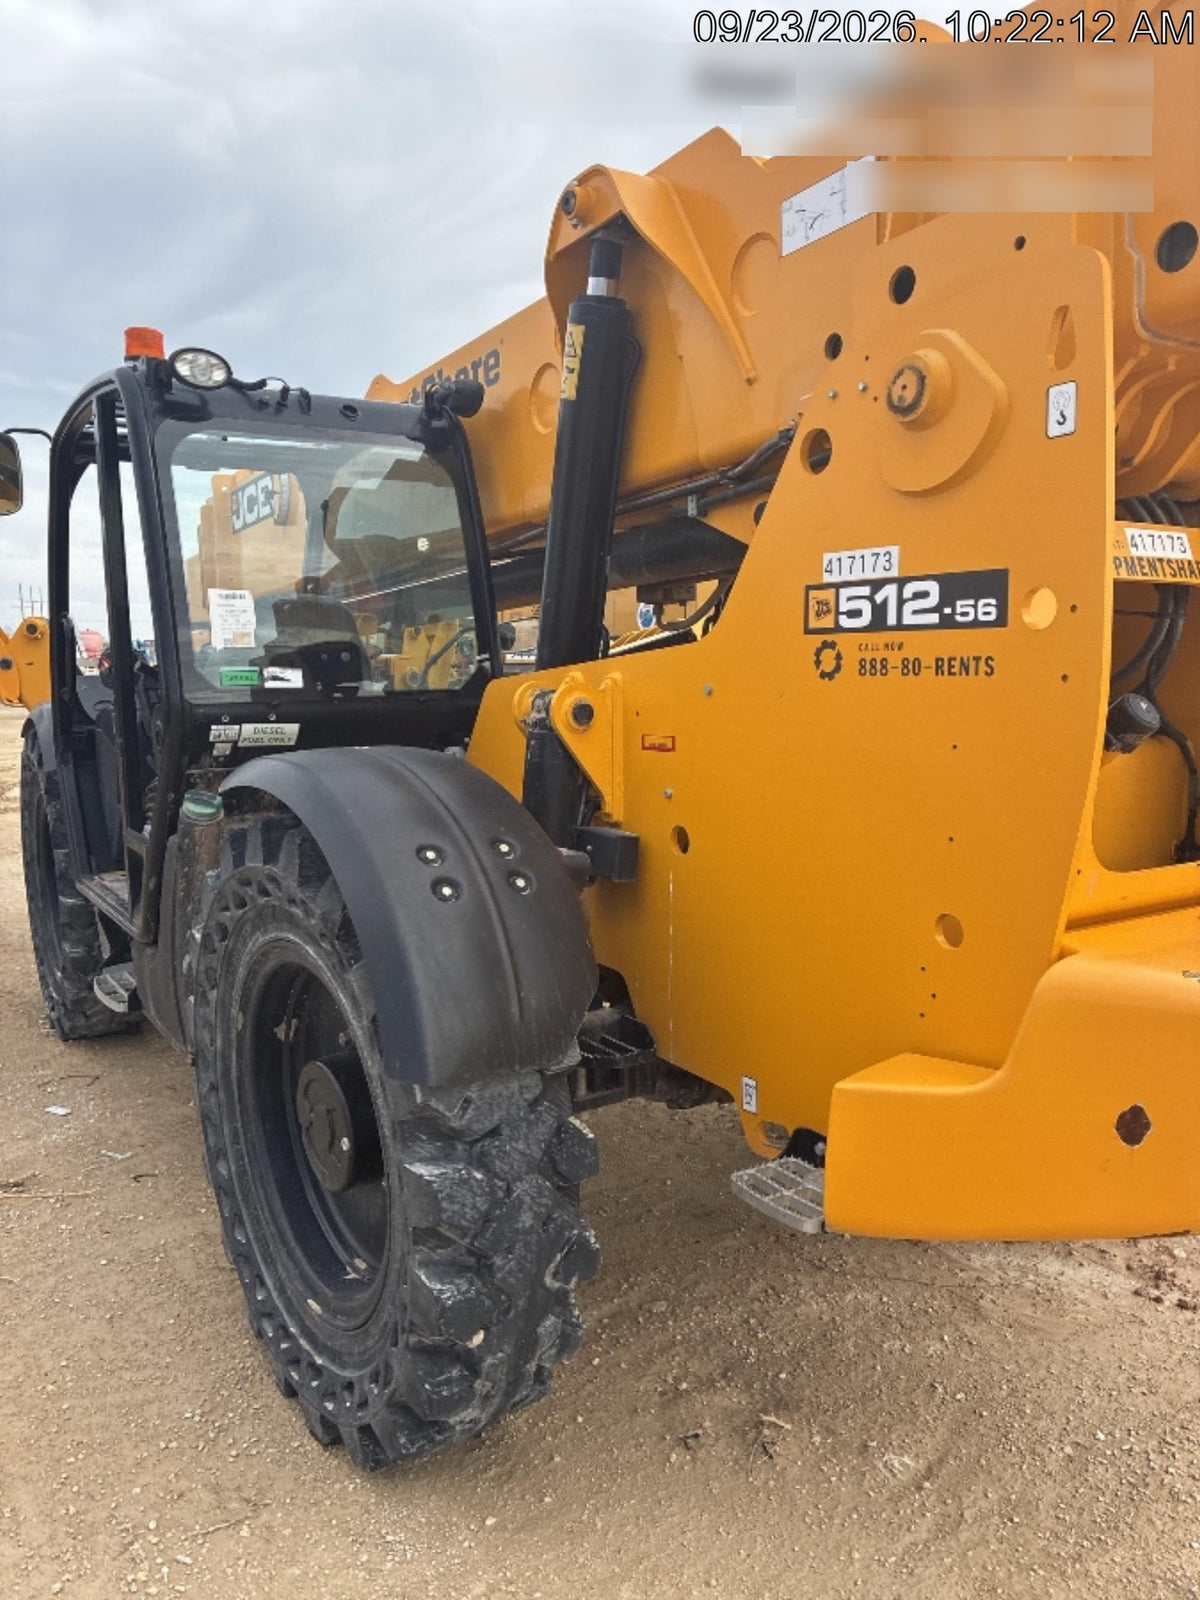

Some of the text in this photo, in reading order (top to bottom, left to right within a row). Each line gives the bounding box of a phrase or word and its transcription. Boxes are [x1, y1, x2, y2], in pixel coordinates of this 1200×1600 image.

[1130, 533, 1187, 554] 417173
[824, 550, 893, 576] 417173
[858, 641, 904, 652] CALL NOW
[858, 656, 995, 676] 888-80-RENTS
[253, 726, 287, 735] DIESEL
